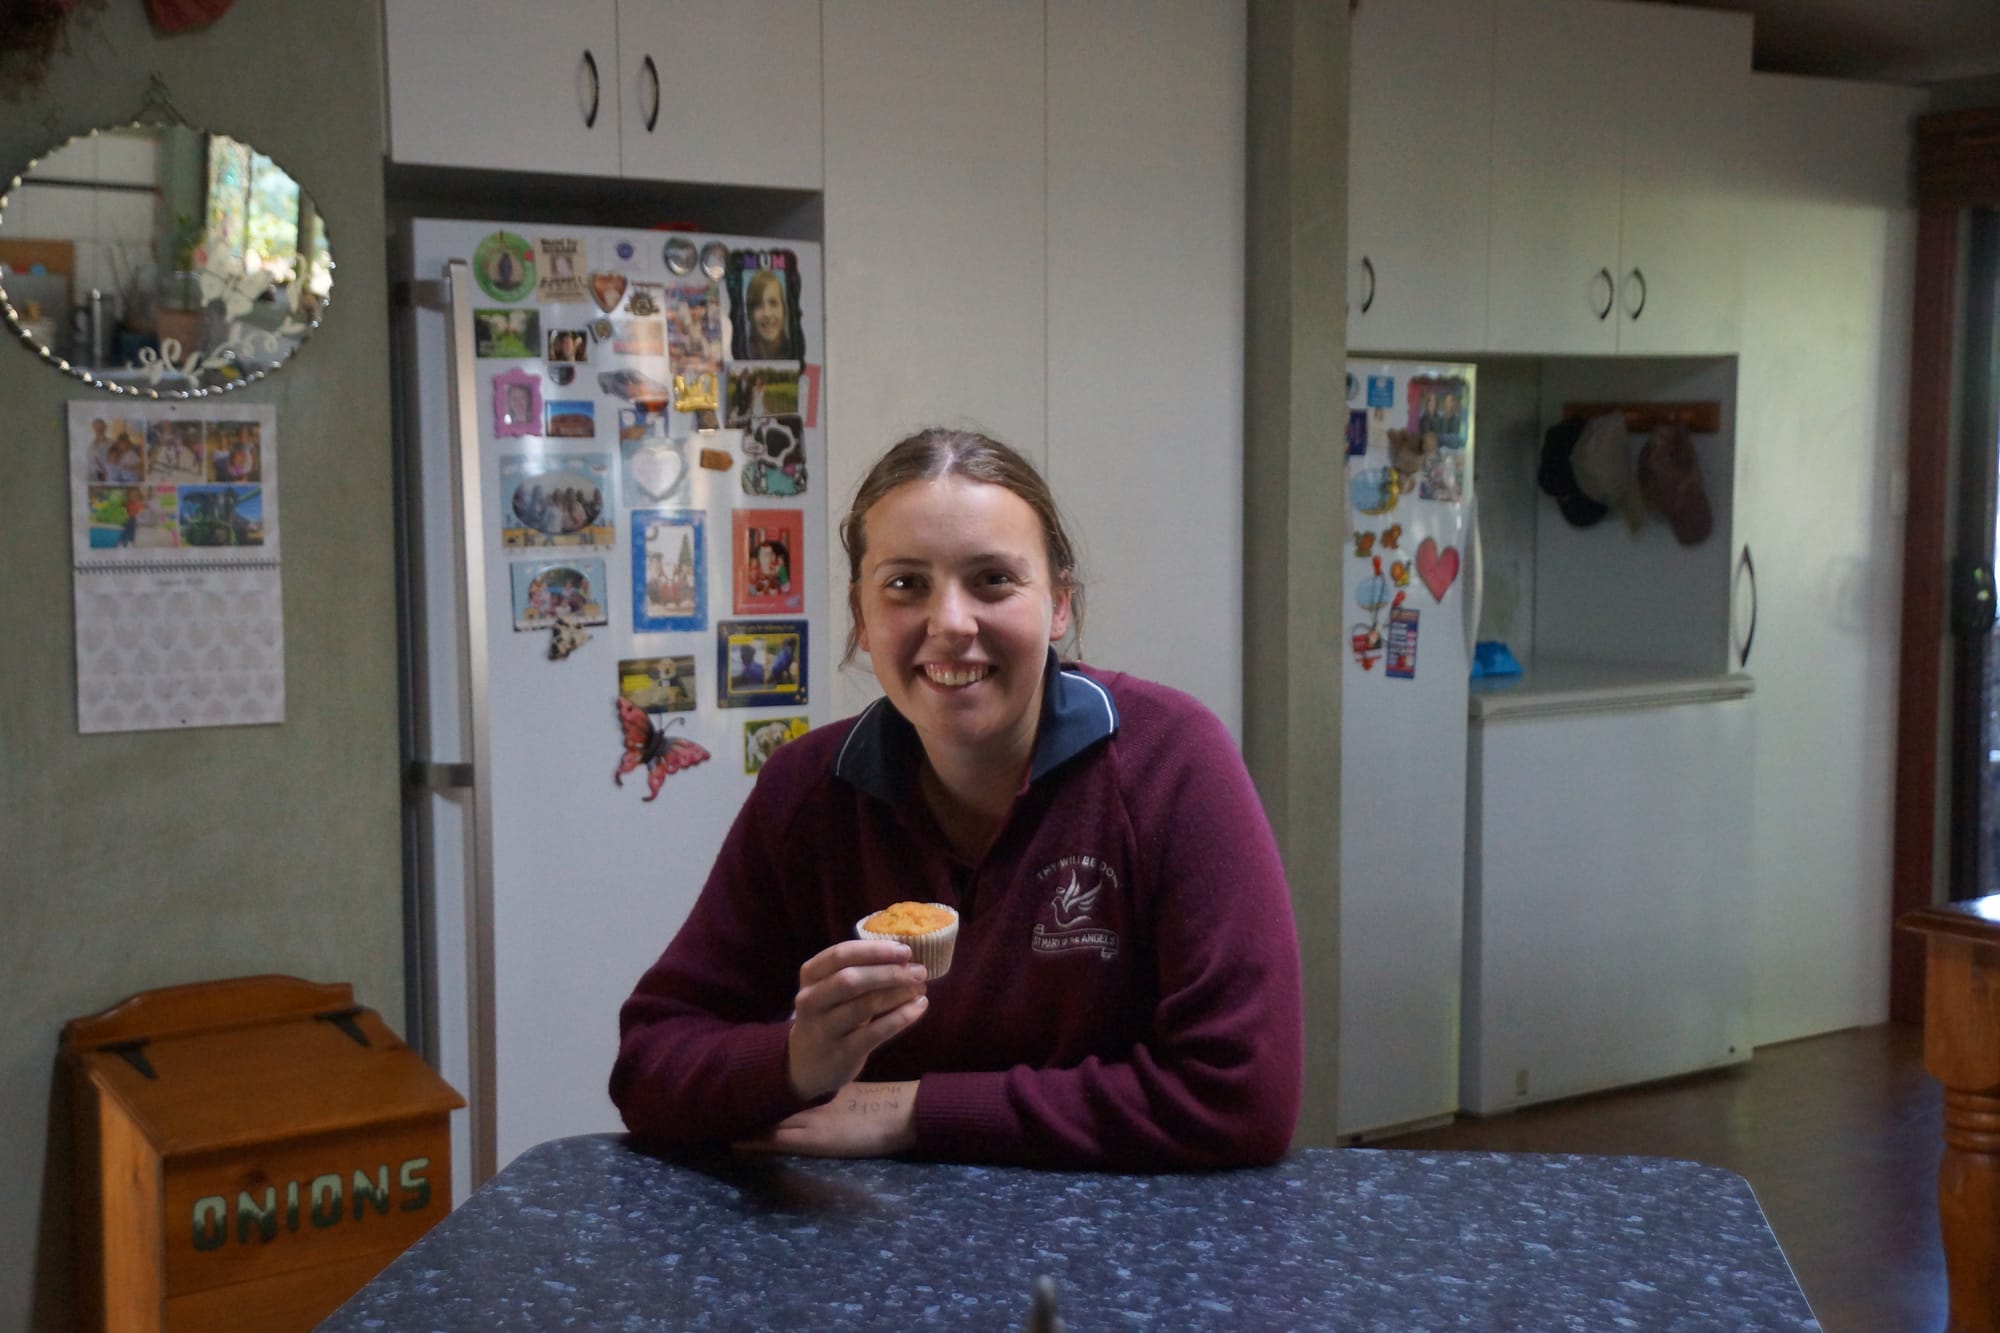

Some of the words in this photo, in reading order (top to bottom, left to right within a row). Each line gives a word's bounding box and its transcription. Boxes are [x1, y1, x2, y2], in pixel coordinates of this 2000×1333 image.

[743, 253, 785, 269] MUM
[1081, 855, 1097, 868] BE
[1042, 936, 1060, 948] MARY
[1081, 933, 1116, 945] ANGELS
[191, 1156, 432, 1251] ONIONS
